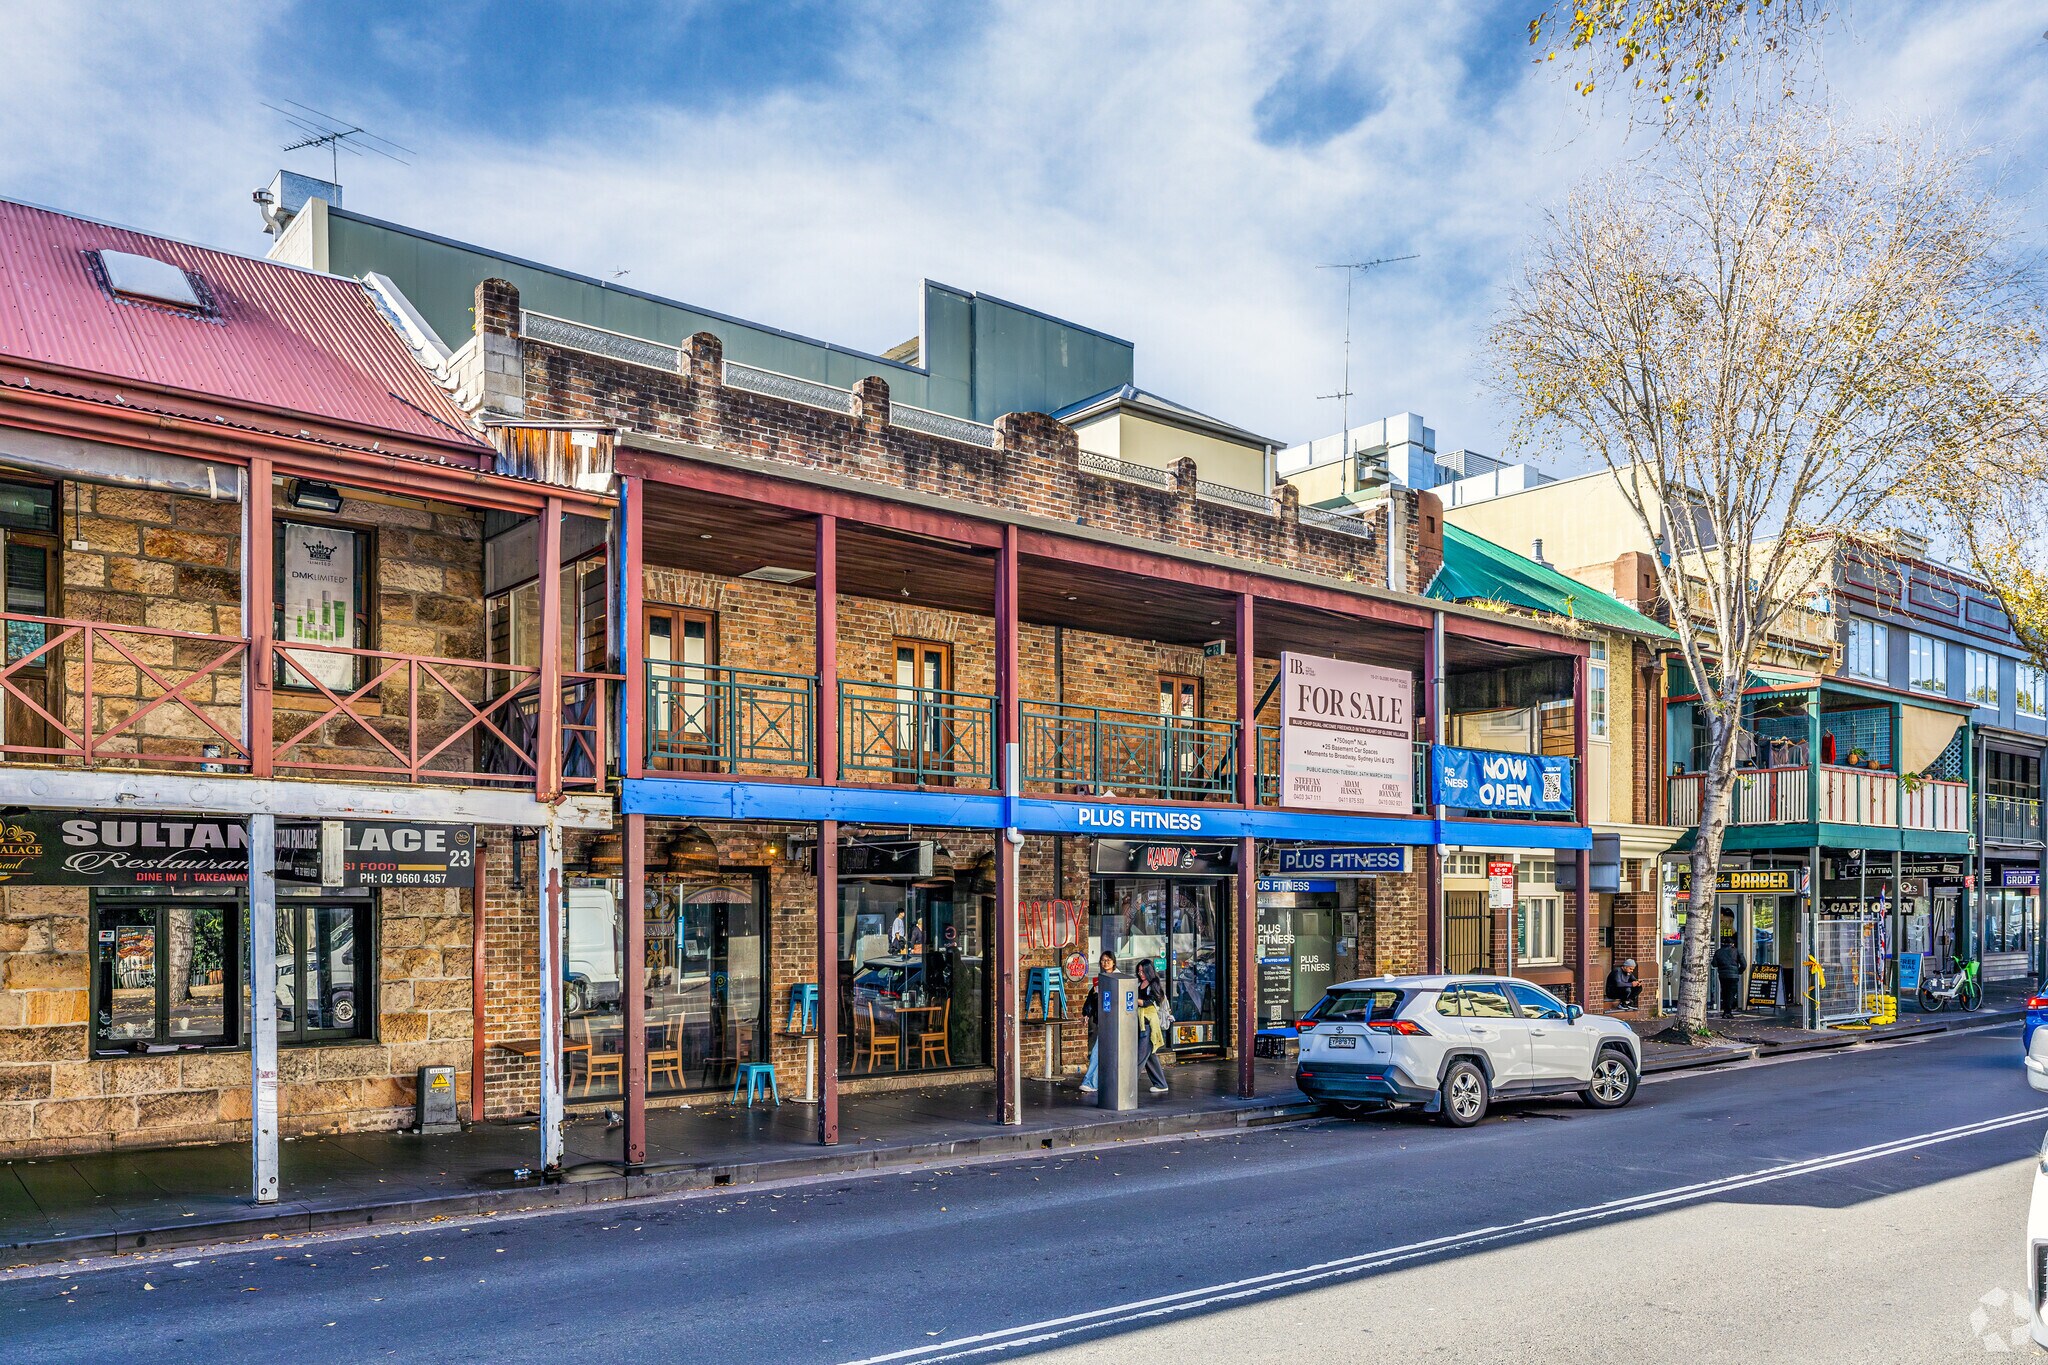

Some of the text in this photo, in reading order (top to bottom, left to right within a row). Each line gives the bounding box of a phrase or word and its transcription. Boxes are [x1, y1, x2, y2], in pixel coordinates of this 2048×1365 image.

[1298, 684, 1402, 724] FOR SALE
[1363, 748, 1378, 756] Spaces
[1358, 755, 1373, 763] Sydney
[1484, 757, 1527, 780] NOW
[1293, 784, 1322, 792] IPPOLITO
[1480, 783, 1532, 806] OPEN
[1079, 808, 1201, 831] PLUS FITNESS
[62, 820, 248, 848] SULTAN
[291, 829, 317, 849] PALACE
[344, 828, 446, 852] LACE
[0, 845, 43, 854] ALACE
[450, 850, 470, 867] 23
[1147, 847, 1180, 871] KANDY
[1286, 852, 1400, 869] PLUS FITNESS
[360, 863, 396, 871] FOOD
[136, 872, 162, 881] DINE
[166, 873, 177, 881] IN
[194, 873, 248, 882] TAKEAWAY
[360, 873, 447, 884] PH: 02 9660 4357
[1731, 872, 1788, 888] BARBER
[2006, 876, 2033, 884] GROUP
[1258, 881, 1309, 890] US FITNESS
[1830, 902, 1914, 913] CAFE OPN
[1018, 900, 1086, 950] ANDY
[1258, 924, 1280, 934] PLUS
[1258, 934, 1295, 944] FITNESS
[1300, 964, 1330, 972] FITNESS
